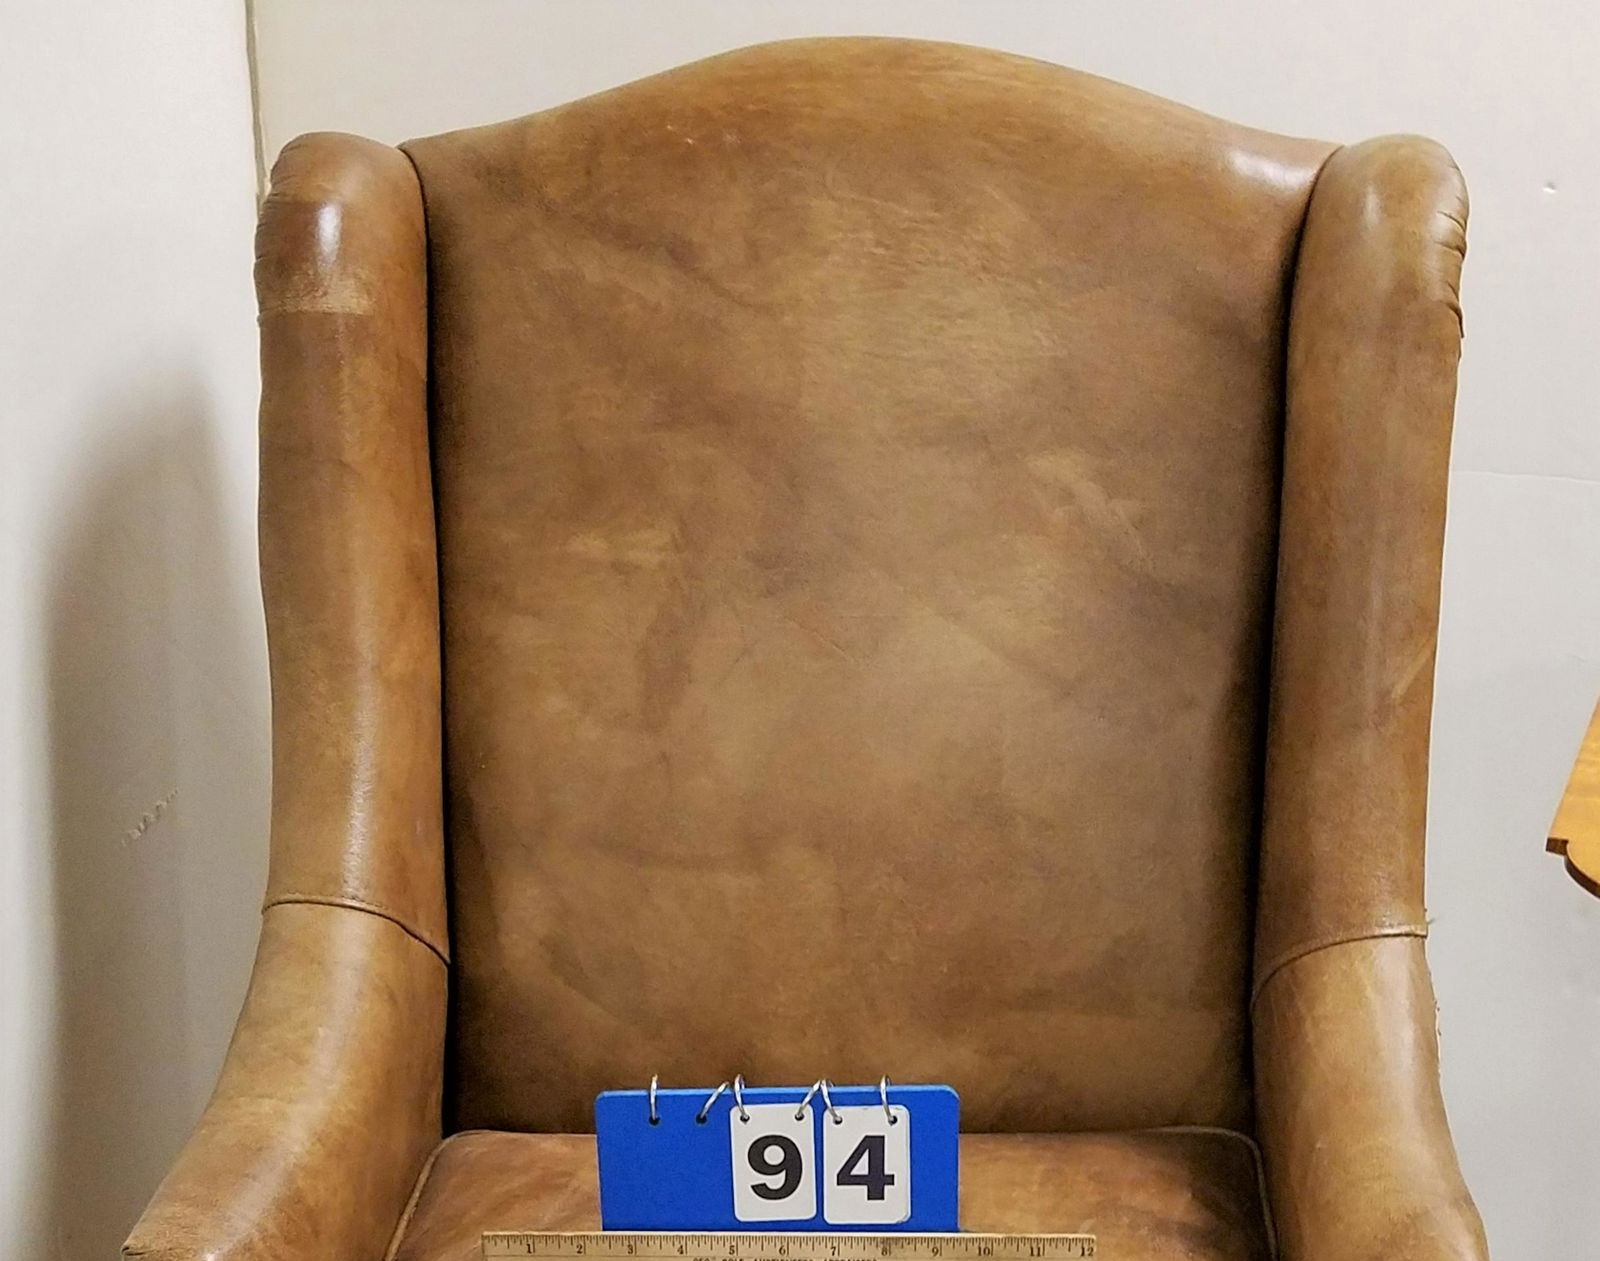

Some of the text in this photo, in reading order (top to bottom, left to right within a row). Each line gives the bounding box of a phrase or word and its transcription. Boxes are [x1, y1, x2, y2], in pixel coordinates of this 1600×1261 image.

[526, 1243, 1094, 1257] 1 2 3 4 5 6 7 8 9 10 11 12
